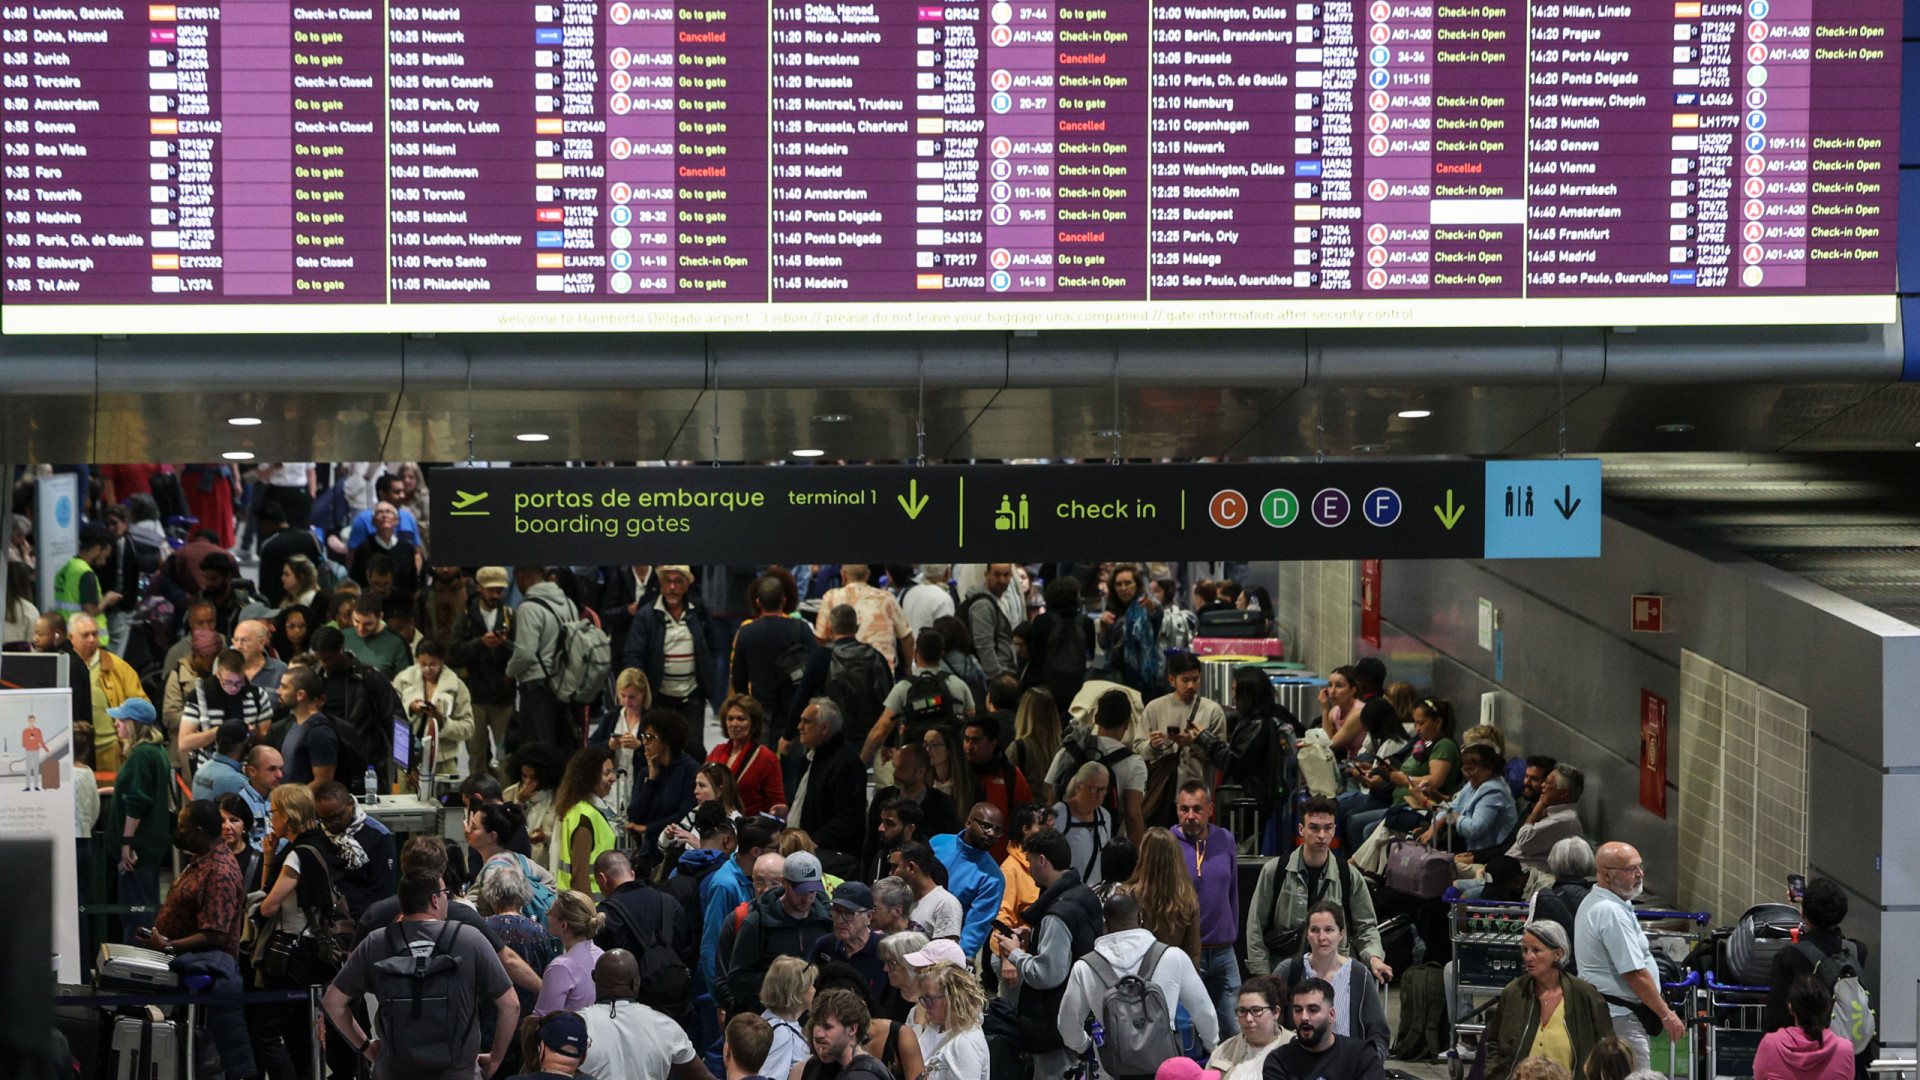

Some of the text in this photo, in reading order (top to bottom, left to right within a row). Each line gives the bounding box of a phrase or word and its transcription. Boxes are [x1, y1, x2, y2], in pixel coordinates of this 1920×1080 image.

[294, 8, 372, 19] Check-in Closed
[390, 8, 418, 20] 10:20
[422, 8, 460, 20] Madrid
[633, 9, 672, 19] A01-A30
[679, 9, 726, 22] Go to gate
[773, 8, 801, 20] 11:15
[837, 4, 874, 15] Hamad
[1154, 7, 1181, 19] 12:00
[1185, 7, 1286, 22] Washington, Dulles
[1392, 7, 1432, 17] A01-A30
[1438, 6, 1506, 19] Check-in Open
[1532, 5, 1559, 17] 14:20
[1563, 5, 1631, 18] Milan, Linate
[295, 31, 343, 44] Go to gate
[422, 31, 464, 42] Newark
[678, 32, 727, 42] Cancelled
[773, 31, 801, 43] 11:20
[805, 31, 881, 43] Rio de Janeiro
[1014, 31, 1053, 41] A01-A30
[1060, 30, 1127, 43] Check-in Open
[1185, 29, 1292, 44] Berlin, Brandenburg
[1563, 28, 1600, 42] Prague
[1770, 27, 1809, 37] A01-A30
[1816, 26, 1884, 38] Check-in Open
[805, 53, 859, 65] Barcelona
[1059, 53, 1107, 64] Cancelled
[1185, 52, 1231, 64] Brussels
[1562, 50, 1628, 64] Porto Alegre
[422, 76, 493, 88] Gran Canaria
[805, 76, 852, 88] Brussels
[1153, 75, 1180, 86] 12:10
[805, 98, 903, 111] Montreal, Trudeau
[1184, 97, 1233, 111] Hamburg
[1561, 94, 1646, 108] Warsaw, Chopin
[805, 121, 908, 133] Brussels, Charleroi
[1184, 119, 1249, 133] Copenhagen
[1561, 117, 1599, 129] Munich
[1184, 142, 1225, 153] Newark
[1770, 138, 1805, 148] 109-114
[391, 166, 419, 177] 10:40
[423, 166, 478, 177] Eindhoven
[805, 166, 842, 177] Madrid
[1017, 166, 1049, 175] 97-100
[1435, 163, 1483, 173] Cancelled
[423, 188, 465, 200] Toronto
[1015, 188, 1051, 197] 101-104
[1183, 186, 1239, 197] Stockholm
[1560, 184, 1617, 195] Marrakech
[1812, 204, 1879, 216] Check-in Open
[423, 211, 467, 222] Istanbul
[391, 233, 420, 245] 11:00
[423, 234, 521, 246] London, Heathrow
[1183, 230, 1238, 244] Paris, Orly
[1528, 228, 1556, 240] 14:45
[1560, 228, 1609, 240] Frankfurt
[296, 257, 353, 267] Gate Closed
[424, 256, 486, 267] Porto Santo
[641, 256, 666, 266] 14-18
[679, 256, 748, 268] Check-in Open
[773, 255, 801, 266] 11:45
[805, 255, 842, 266] Boston
[392, 278, 420, 289] 11:05
[1020, 277, 1045, 286] 14-18
[1152, 275, 1179, 286] 12:30
[1205, 275, 1236, 286] Paulo,
[1239, 275, 1292, 285] Guarulhos
[1581, 273, 1612, 284] Paulo,
[1615, 272, 1668, 283] Guarulhos
[424, 278, 490, 292] Philadelphia
[498, 314, 557, 324] welcome
[561, 313, 574, 324] to
[578, 313, 643, 324] Humberto
[649, 313, 702, 326] Delgado
[706, 313, 750, 325] airport
[764, 312, 807, 323] Lisbon
[826, 312, 867, 325] please
[872, 312, 888, 323] do
[892, 313, 912, 323] not
[917, 312, 951, 323] leave
[954, 313, 982, 325] your
[987, 311, 1042, 324] baggage
[1047, 311, 1148, 323] unaccompanied
[1167, 311, 1194, 323] gate
[1198, 309, 1274, 320] information
[1278, 310, 1307, 320] after
[1312, 309, 1363, 322] security
[1368, 309, 1413, 320] control
[515, 488, 764, 511] portas de embarque
[788, 490, 877, 505] terminal 1
[1056, 499, 1156, 518] check in
[1220, 499, 1237, 518] C
[1273, 498, 1289, 518] D
[1324, 498, 1338, 517] E
[1376, 497, 1390, 517] F
[515, 514, 690, 538] boarding gates
